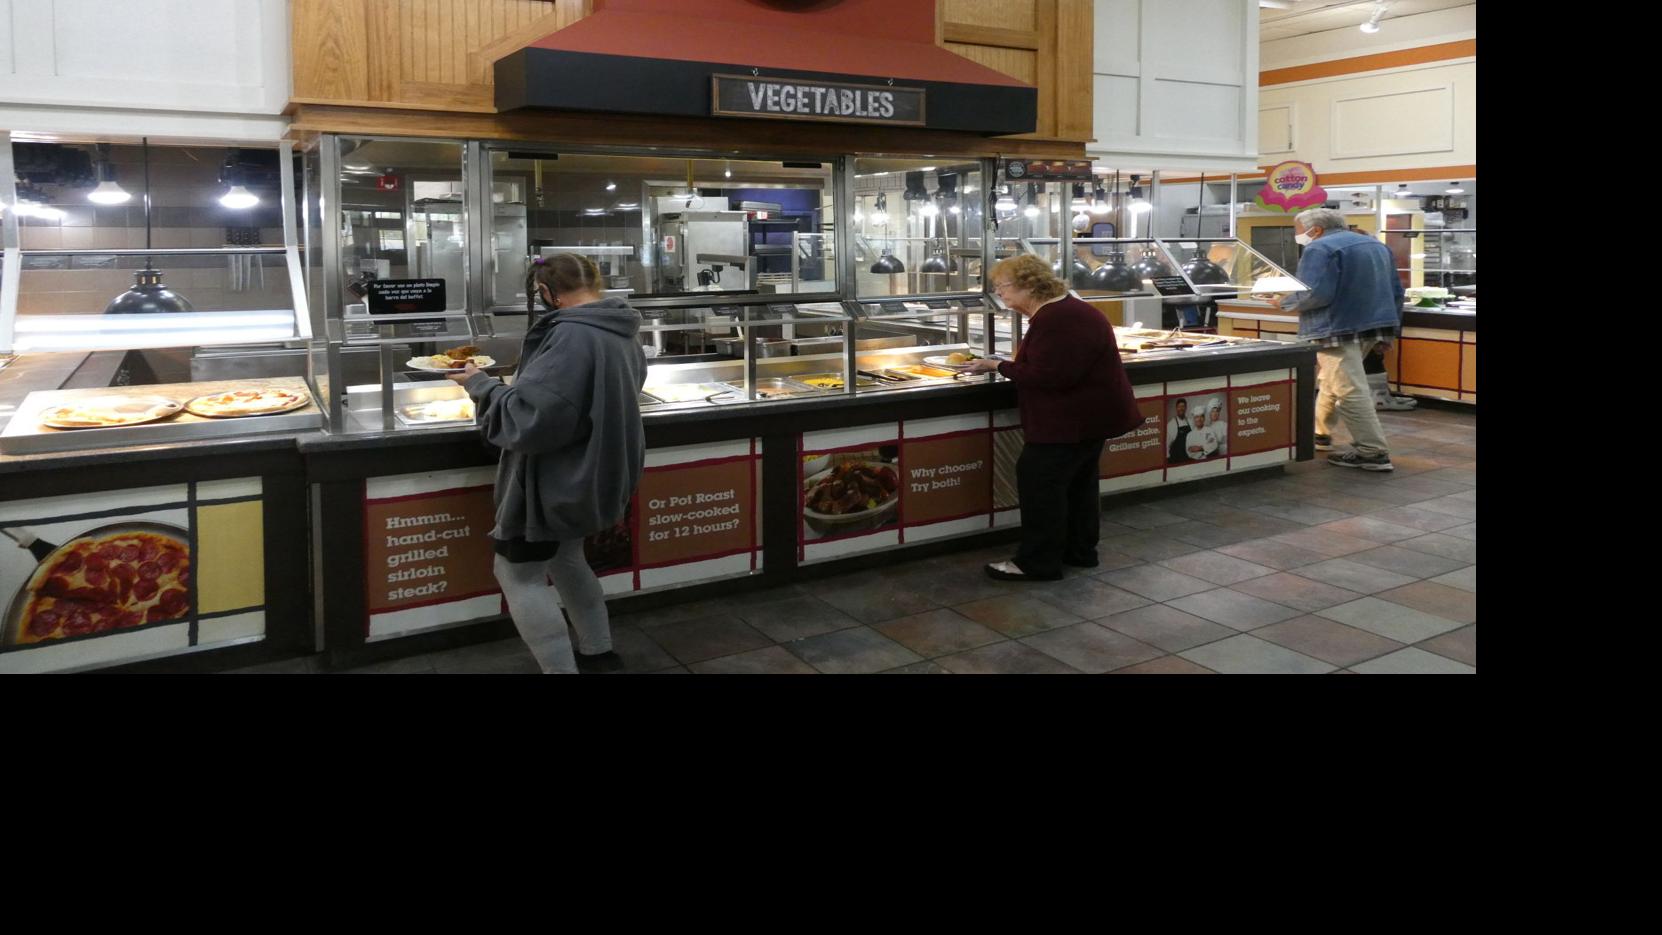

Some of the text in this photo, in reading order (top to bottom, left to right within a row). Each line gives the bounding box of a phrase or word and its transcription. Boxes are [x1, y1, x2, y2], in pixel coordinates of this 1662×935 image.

[747, 82, 895, 118] VEGETABLES
[1274, 175, 1308, 183] cotton
[1277, 182, 1305, 190] candy
[1250, 394, 1271, 403] leave
[1237, 403, 1280, 415] our cooking
[1237, 416, 1258, 426] to the
[1109, 440, 1141, 452] Grillers
[911, 460, 983, 479] Why choose?
[911, 476, 961, 493] Try both!
[648, 488, 736, 510] Or Pot Roast
[385, 513, 465, 530] Hmmm...
[648, 503, 740, 526] slow-cooked
[386, 525, 471, 547] hand-cut
[648, 518, 740, 542] for 12 hours?
[386, 545, 449, 568] grilled
[387, 565, 446, 583] sirloin
[387, 580, 448, 601] steak?
